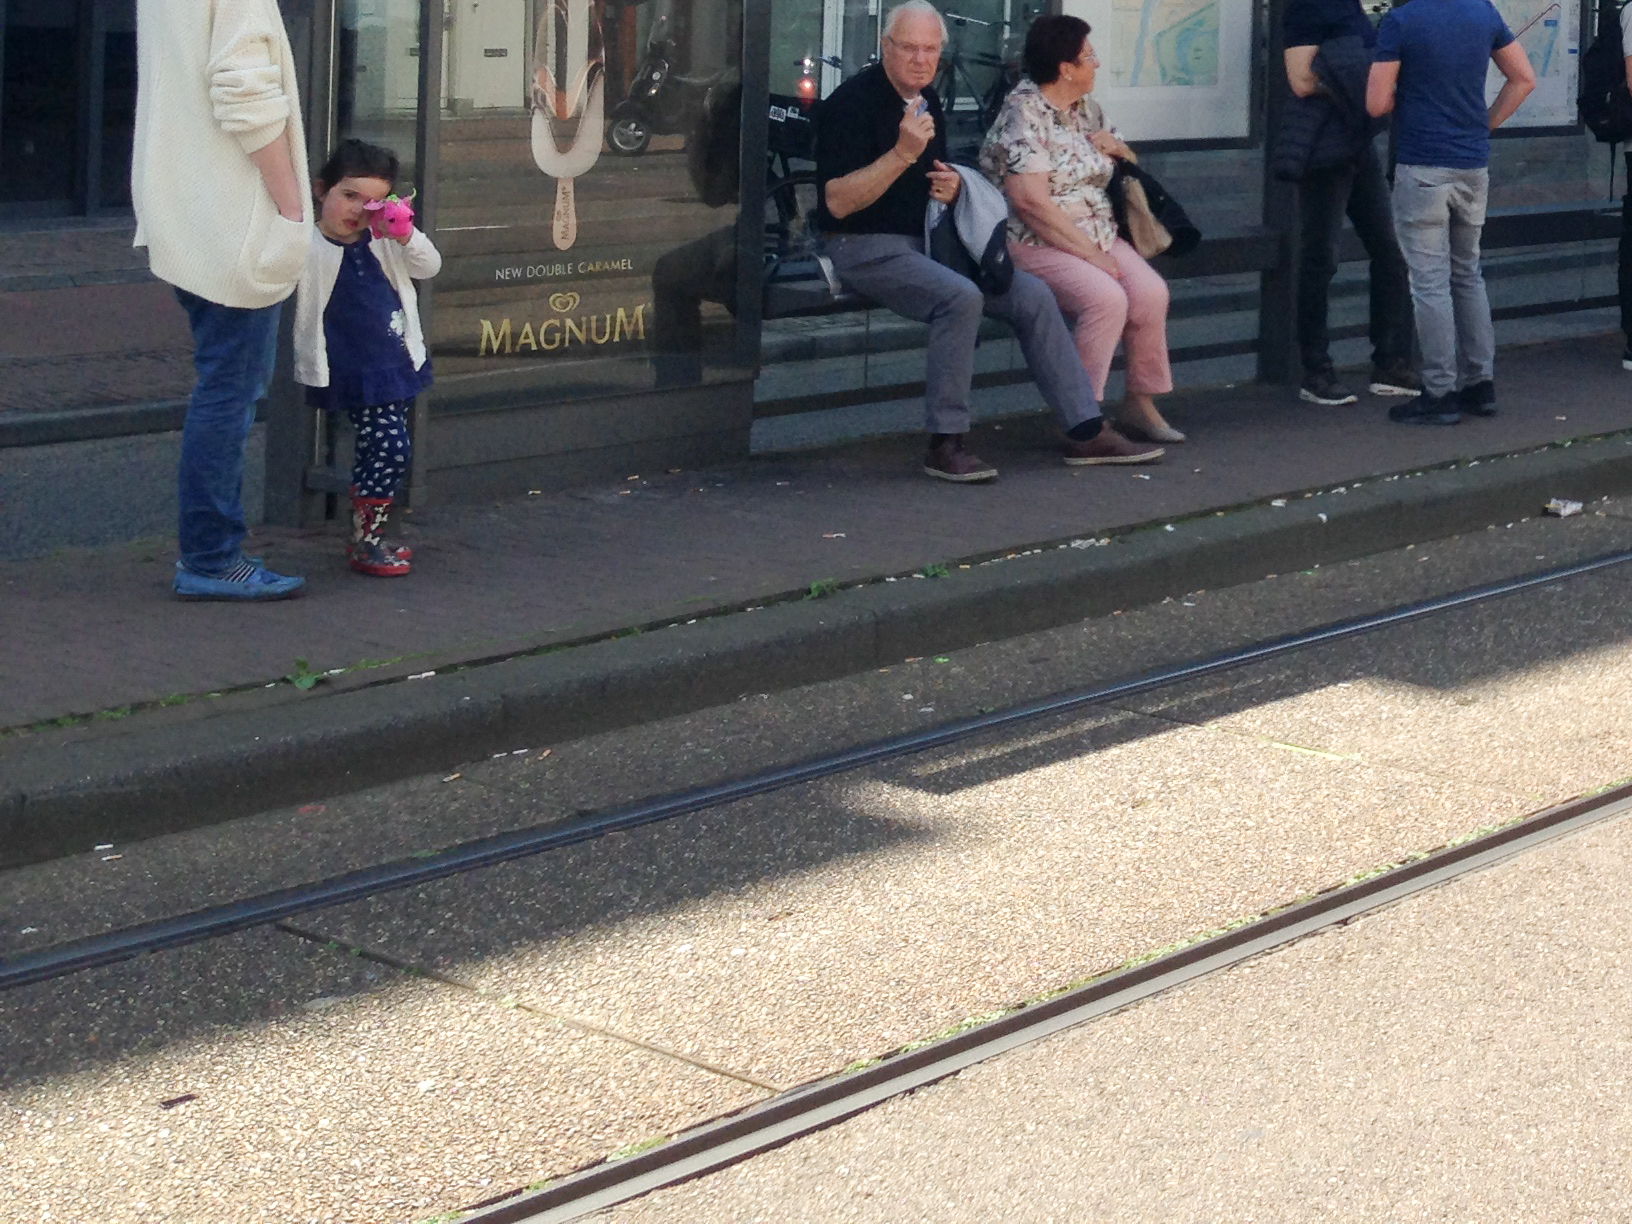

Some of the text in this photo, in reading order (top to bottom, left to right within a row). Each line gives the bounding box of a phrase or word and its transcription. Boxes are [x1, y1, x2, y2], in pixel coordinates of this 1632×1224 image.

[495, 259, 633, 281] NEW DOUBLE CARAMEL
[478, 304, 646, 356] MAGNUM
